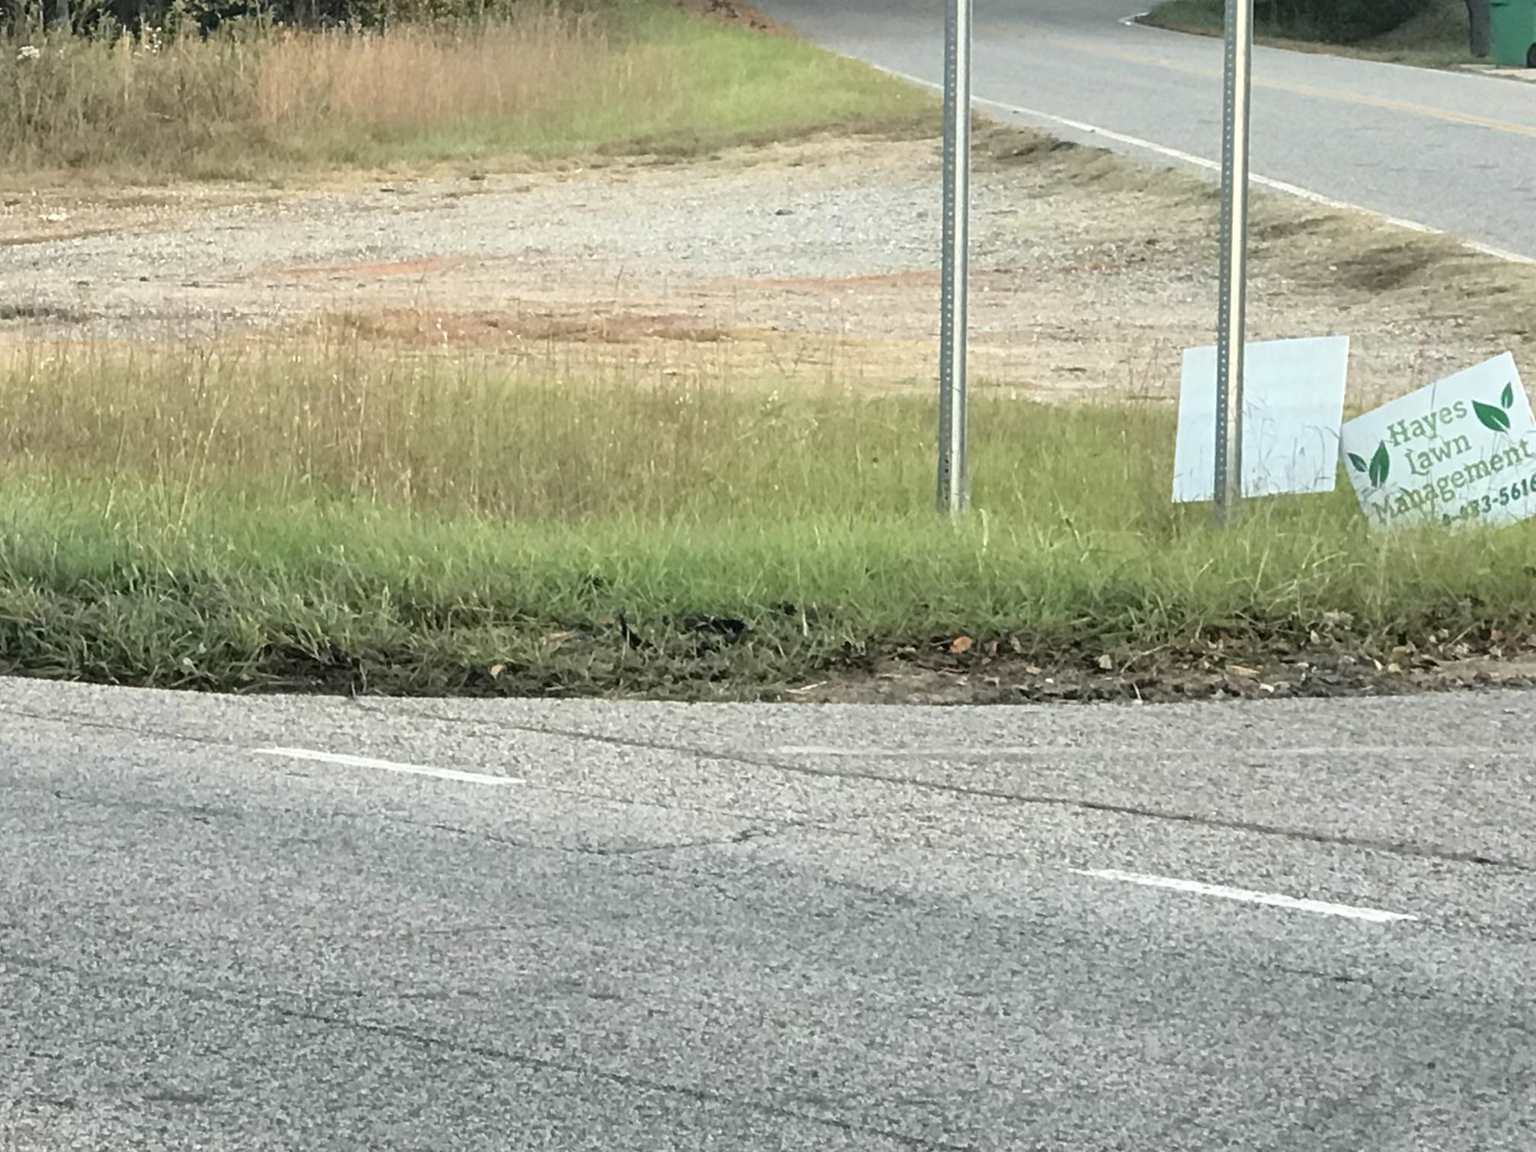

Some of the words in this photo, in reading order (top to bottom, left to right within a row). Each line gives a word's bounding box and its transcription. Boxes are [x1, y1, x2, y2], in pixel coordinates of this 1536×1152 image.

[1387, 399, 1468, 447] Hayes
[1405, 433, 1472, 476] Lawn
[1372, 438, 1534, 524] Management
